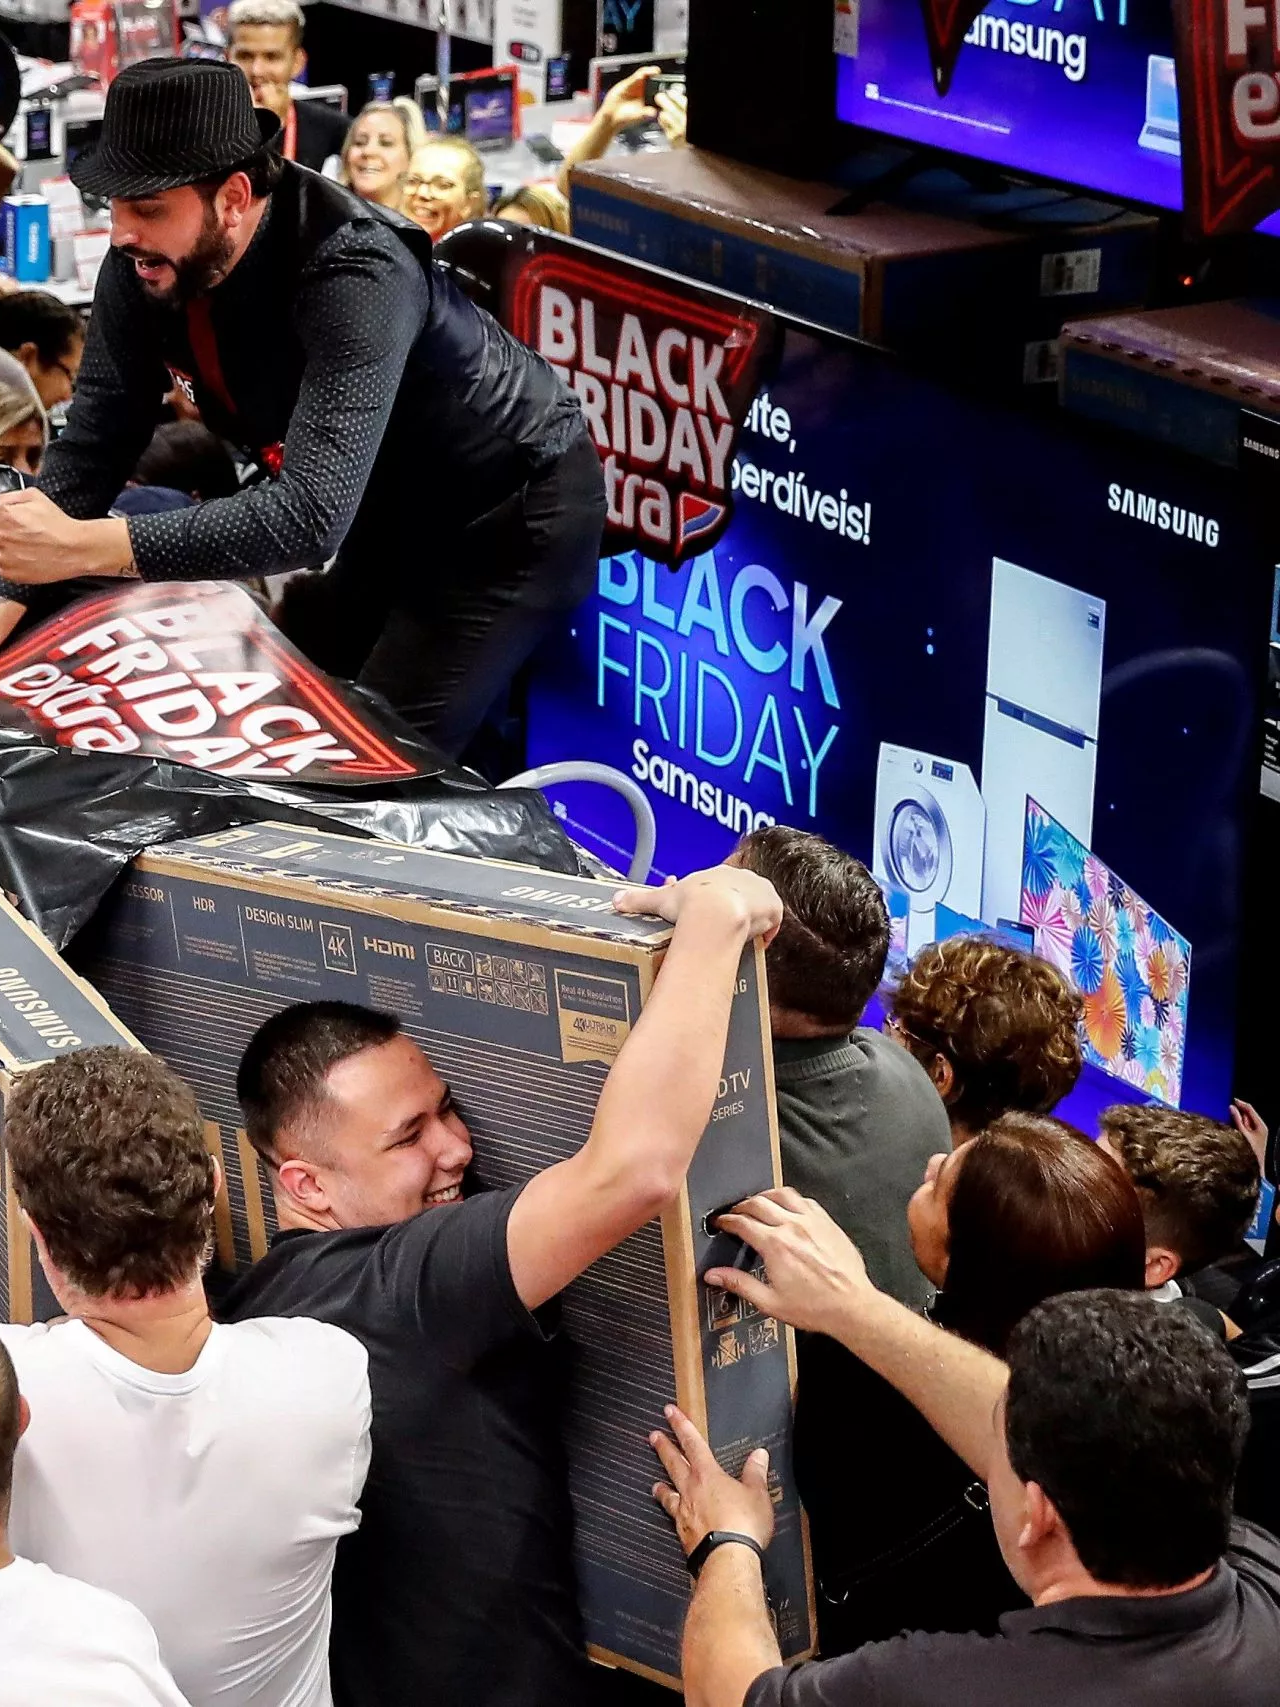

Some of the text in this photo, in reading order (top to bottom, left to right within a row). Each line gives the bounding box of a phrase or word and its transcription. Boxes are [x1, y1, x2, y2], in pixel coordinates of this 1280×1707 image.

[963, 13, 1088, 84] amsung
[538, 284, 732, 420] BLACK
[1108, 482, 1220, 548] SAMSUNG
[599, 550, 844, 709] BLACK
[60, 616, 294, 778] FRIDAY
[134, 601, 358, 774] BLACK
[598, 612, 840, 817] FRIDAY
[193, 895, 216, 914] HDR
[245, 906, 314, 933] DESIGN SLIM
[327, 935, 348, 958] 4K
[433, 949, 467, 970] BACK
[711, 1100, 745, 1123] SERIES
[729, 1068, 752, 1094] TV
